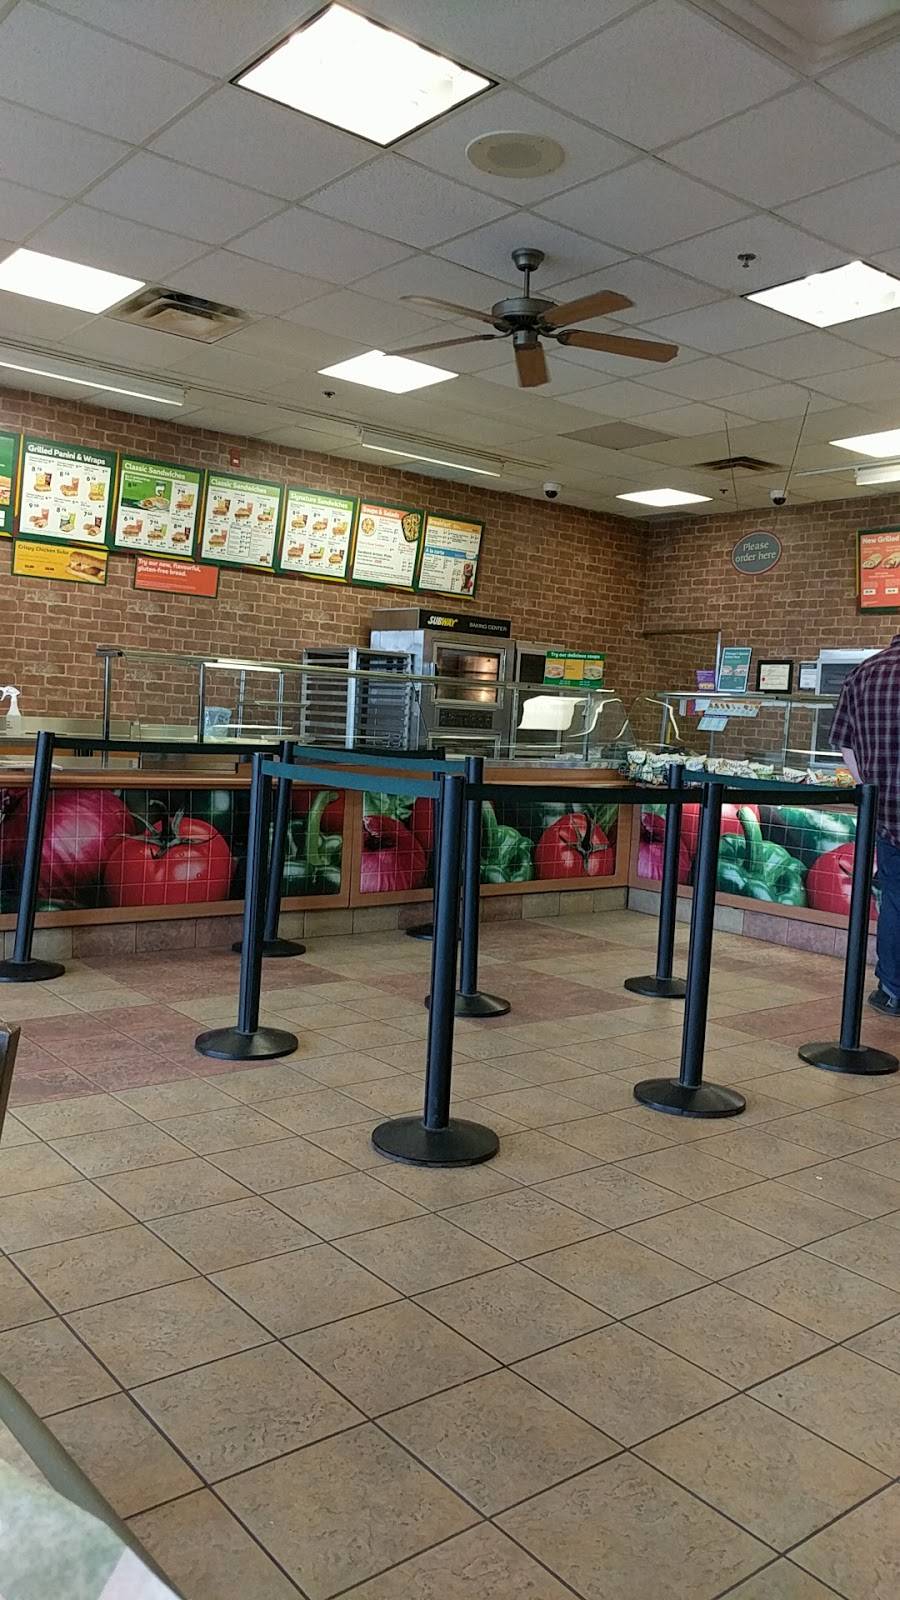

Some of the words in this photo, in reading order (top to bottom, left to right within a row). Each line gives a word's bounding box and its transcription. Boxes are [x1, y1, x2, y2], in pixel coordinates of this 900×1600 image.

[28, 444, 53, 456] Grilled
[53, 449, 76, 460] Panini
[82, 454, 106, 465] Wraps
[124, 462, 148, 473] Classic
[148, 466, 186, 480] Sandwiches
[743, 542, 769, 551] Please
[736, 552, 757, 562] order
[758, 551, 777, 560] here
[427, 615, 457, 627] SUBWAY
